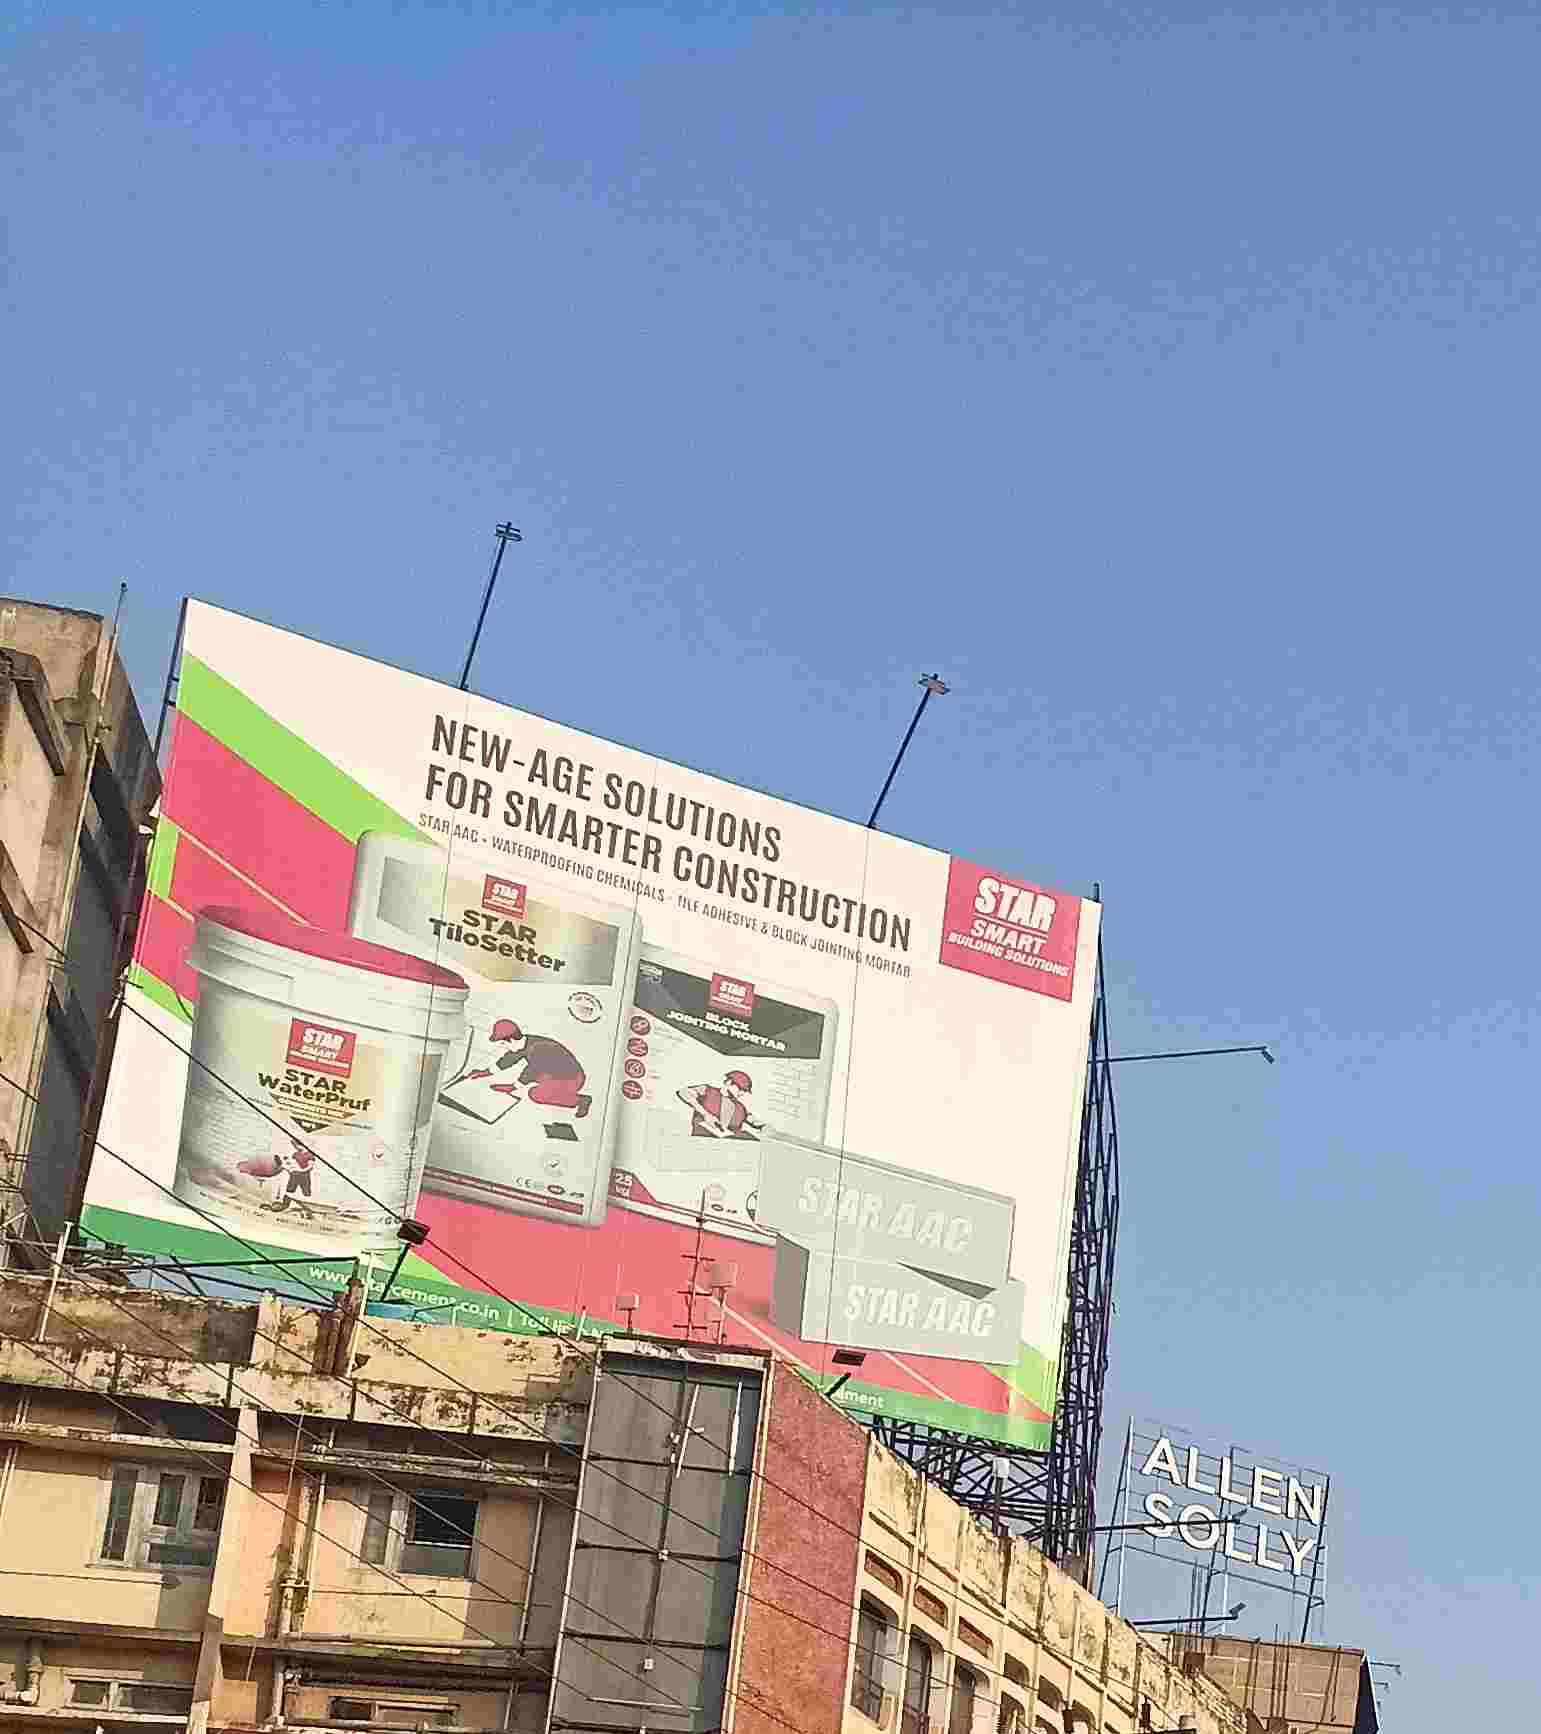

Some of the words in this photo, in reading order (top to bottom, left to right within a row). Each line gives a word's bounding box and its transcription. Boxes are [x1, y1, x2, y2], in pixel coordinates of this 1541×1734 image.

[431, 713, 595, 802] NEW-AGE
[602, 771, 784, 863] SOLUTIONS
[424, 763, 494, 820] FOR
[503, 789, 663, 874] SMARTER
[672, 845, 913, 952] CONSTRUCTION
[418, 811, 452, 835] STAR
[453, 819, 481, 844] AAC
[491, 835, 594, 882] WATERPROOFING
[597, 868, 666, 904] CHEMICALS
[702, 901, 760, 933] ADHESIVE
[772, 920, 809, 947] BLOCK
[810, 931, 863, 964] JOINTING
[864, 949, 913, 979] MORTAR
[974, 875, 1057, 932] STAR
[462, 909, 537, 945] STAR
[970, 918, 1047, 955] SMART
[948, 931, 1004, 958] BUILDING
[1004, 949, 1071, 978] SOLUTIONS
[302, 1027, 345, 1051] STAR
[666, 1009, 730, 1036] JOINTING
[730, 1028, 787, 1052] MORTAR
[705, 1011, 750, 1031] BLOCK
[257, 1071, 372, 1113] WaterPruf
[284, 1067, 348, 1095] STAR
[799, 1176, 886, 1233] STAR
[887, 1201, 974, 1254] AAC
[843, 1283, 919, 1330] STAR
[921, 1295, 997, 1337] AAC
[1139, 1437, 1323, 1527] ALLEN
[1142, 1492, 1314, 1577] SOLLY
